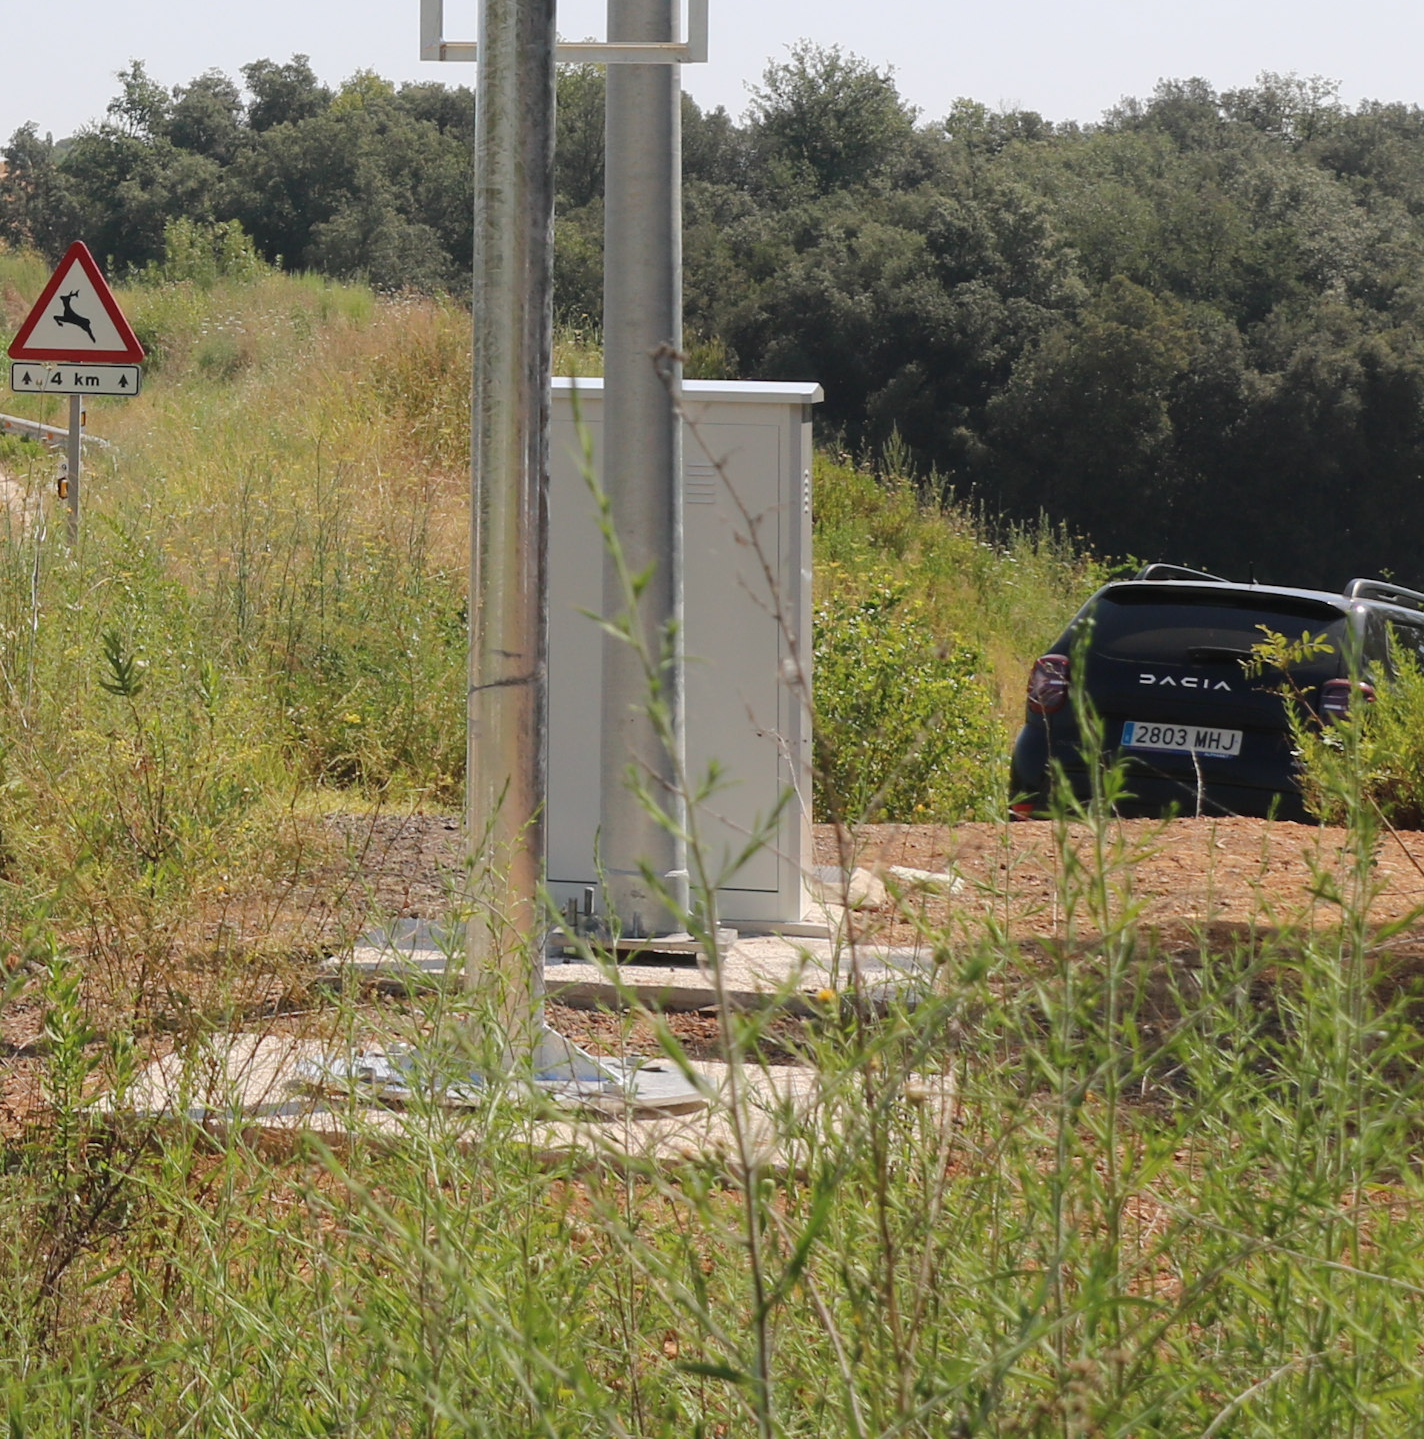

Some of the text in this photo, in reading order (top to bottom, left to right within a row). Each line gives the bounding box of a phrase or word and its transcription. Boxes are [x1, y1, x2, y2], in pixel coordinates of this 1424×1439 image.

[50, 371, 100, 387] 4 km
[1139, 673, 1231, 691] DACIA
[1135, 725, 1235, 751] 2803 MHJ
